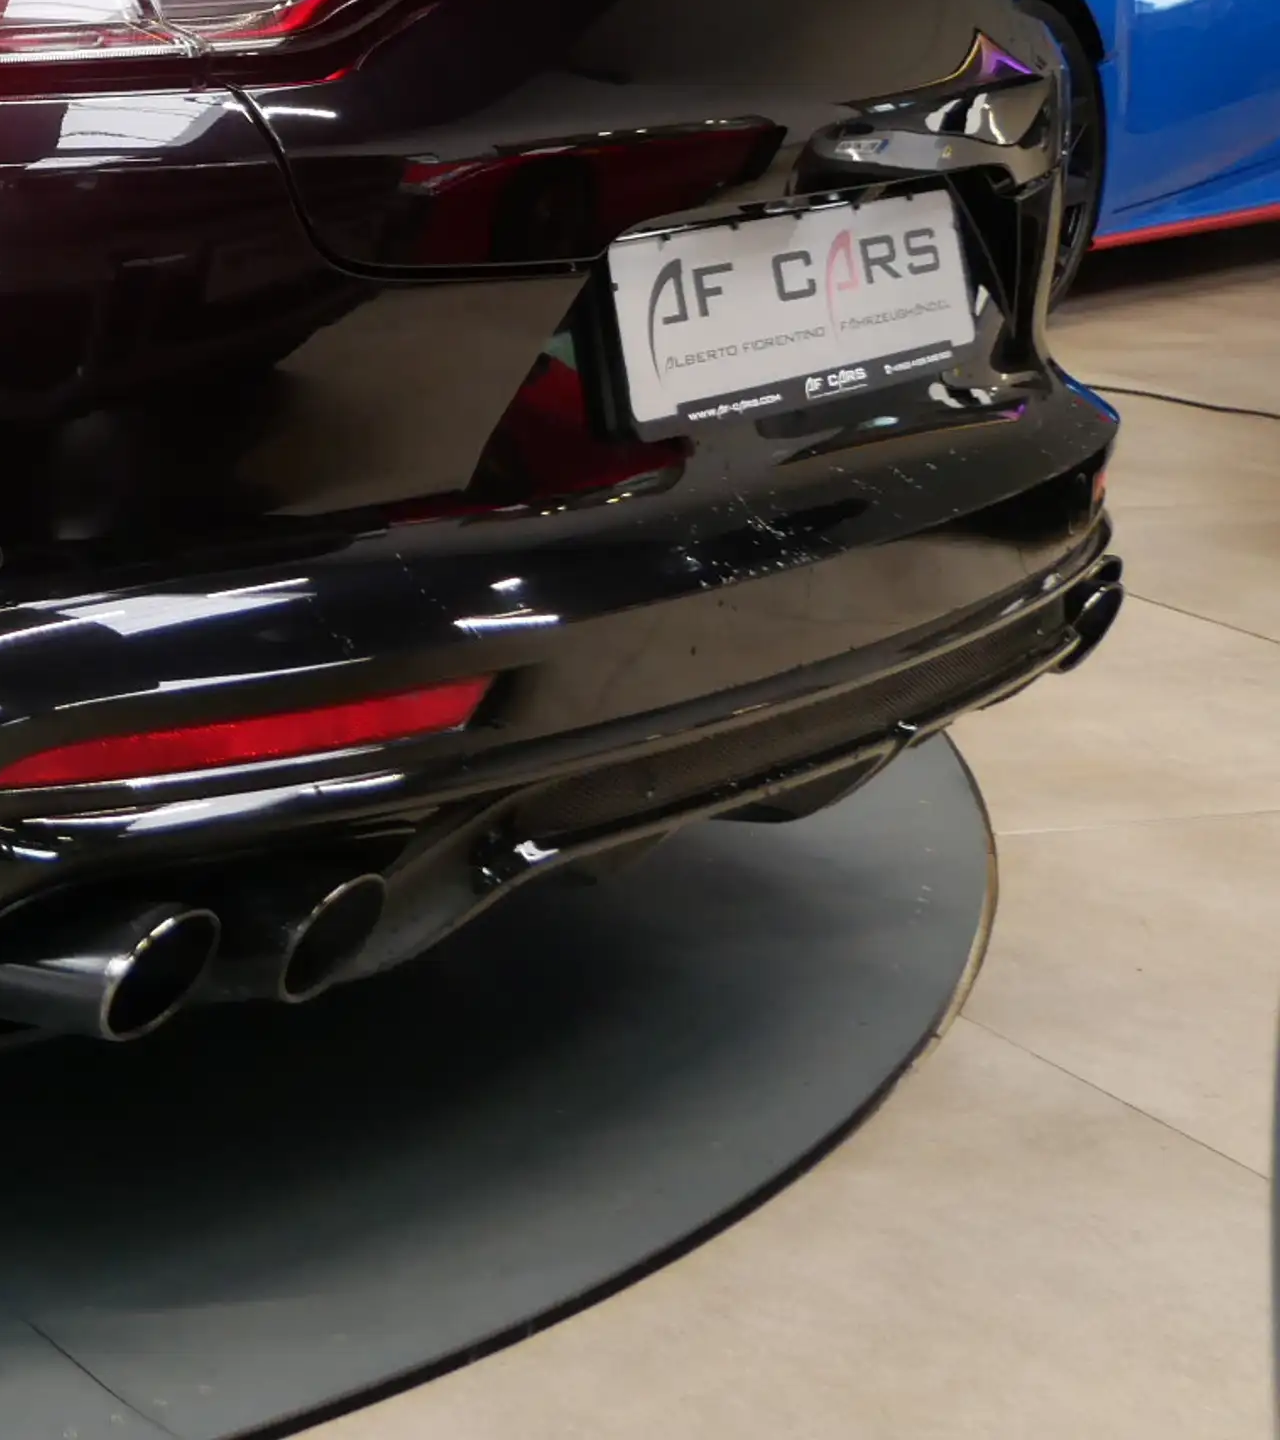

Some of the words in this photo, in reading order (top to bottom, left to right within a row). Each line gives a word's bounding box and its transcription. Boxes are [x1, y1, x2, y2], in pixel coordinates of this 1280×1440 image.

[647, 257, 734, 382] AF
[771, 226, 941, 340] CARS
[663, 344, 738, 372] ALBERTO
[741, 325, 826, 357] FIORENTINO
